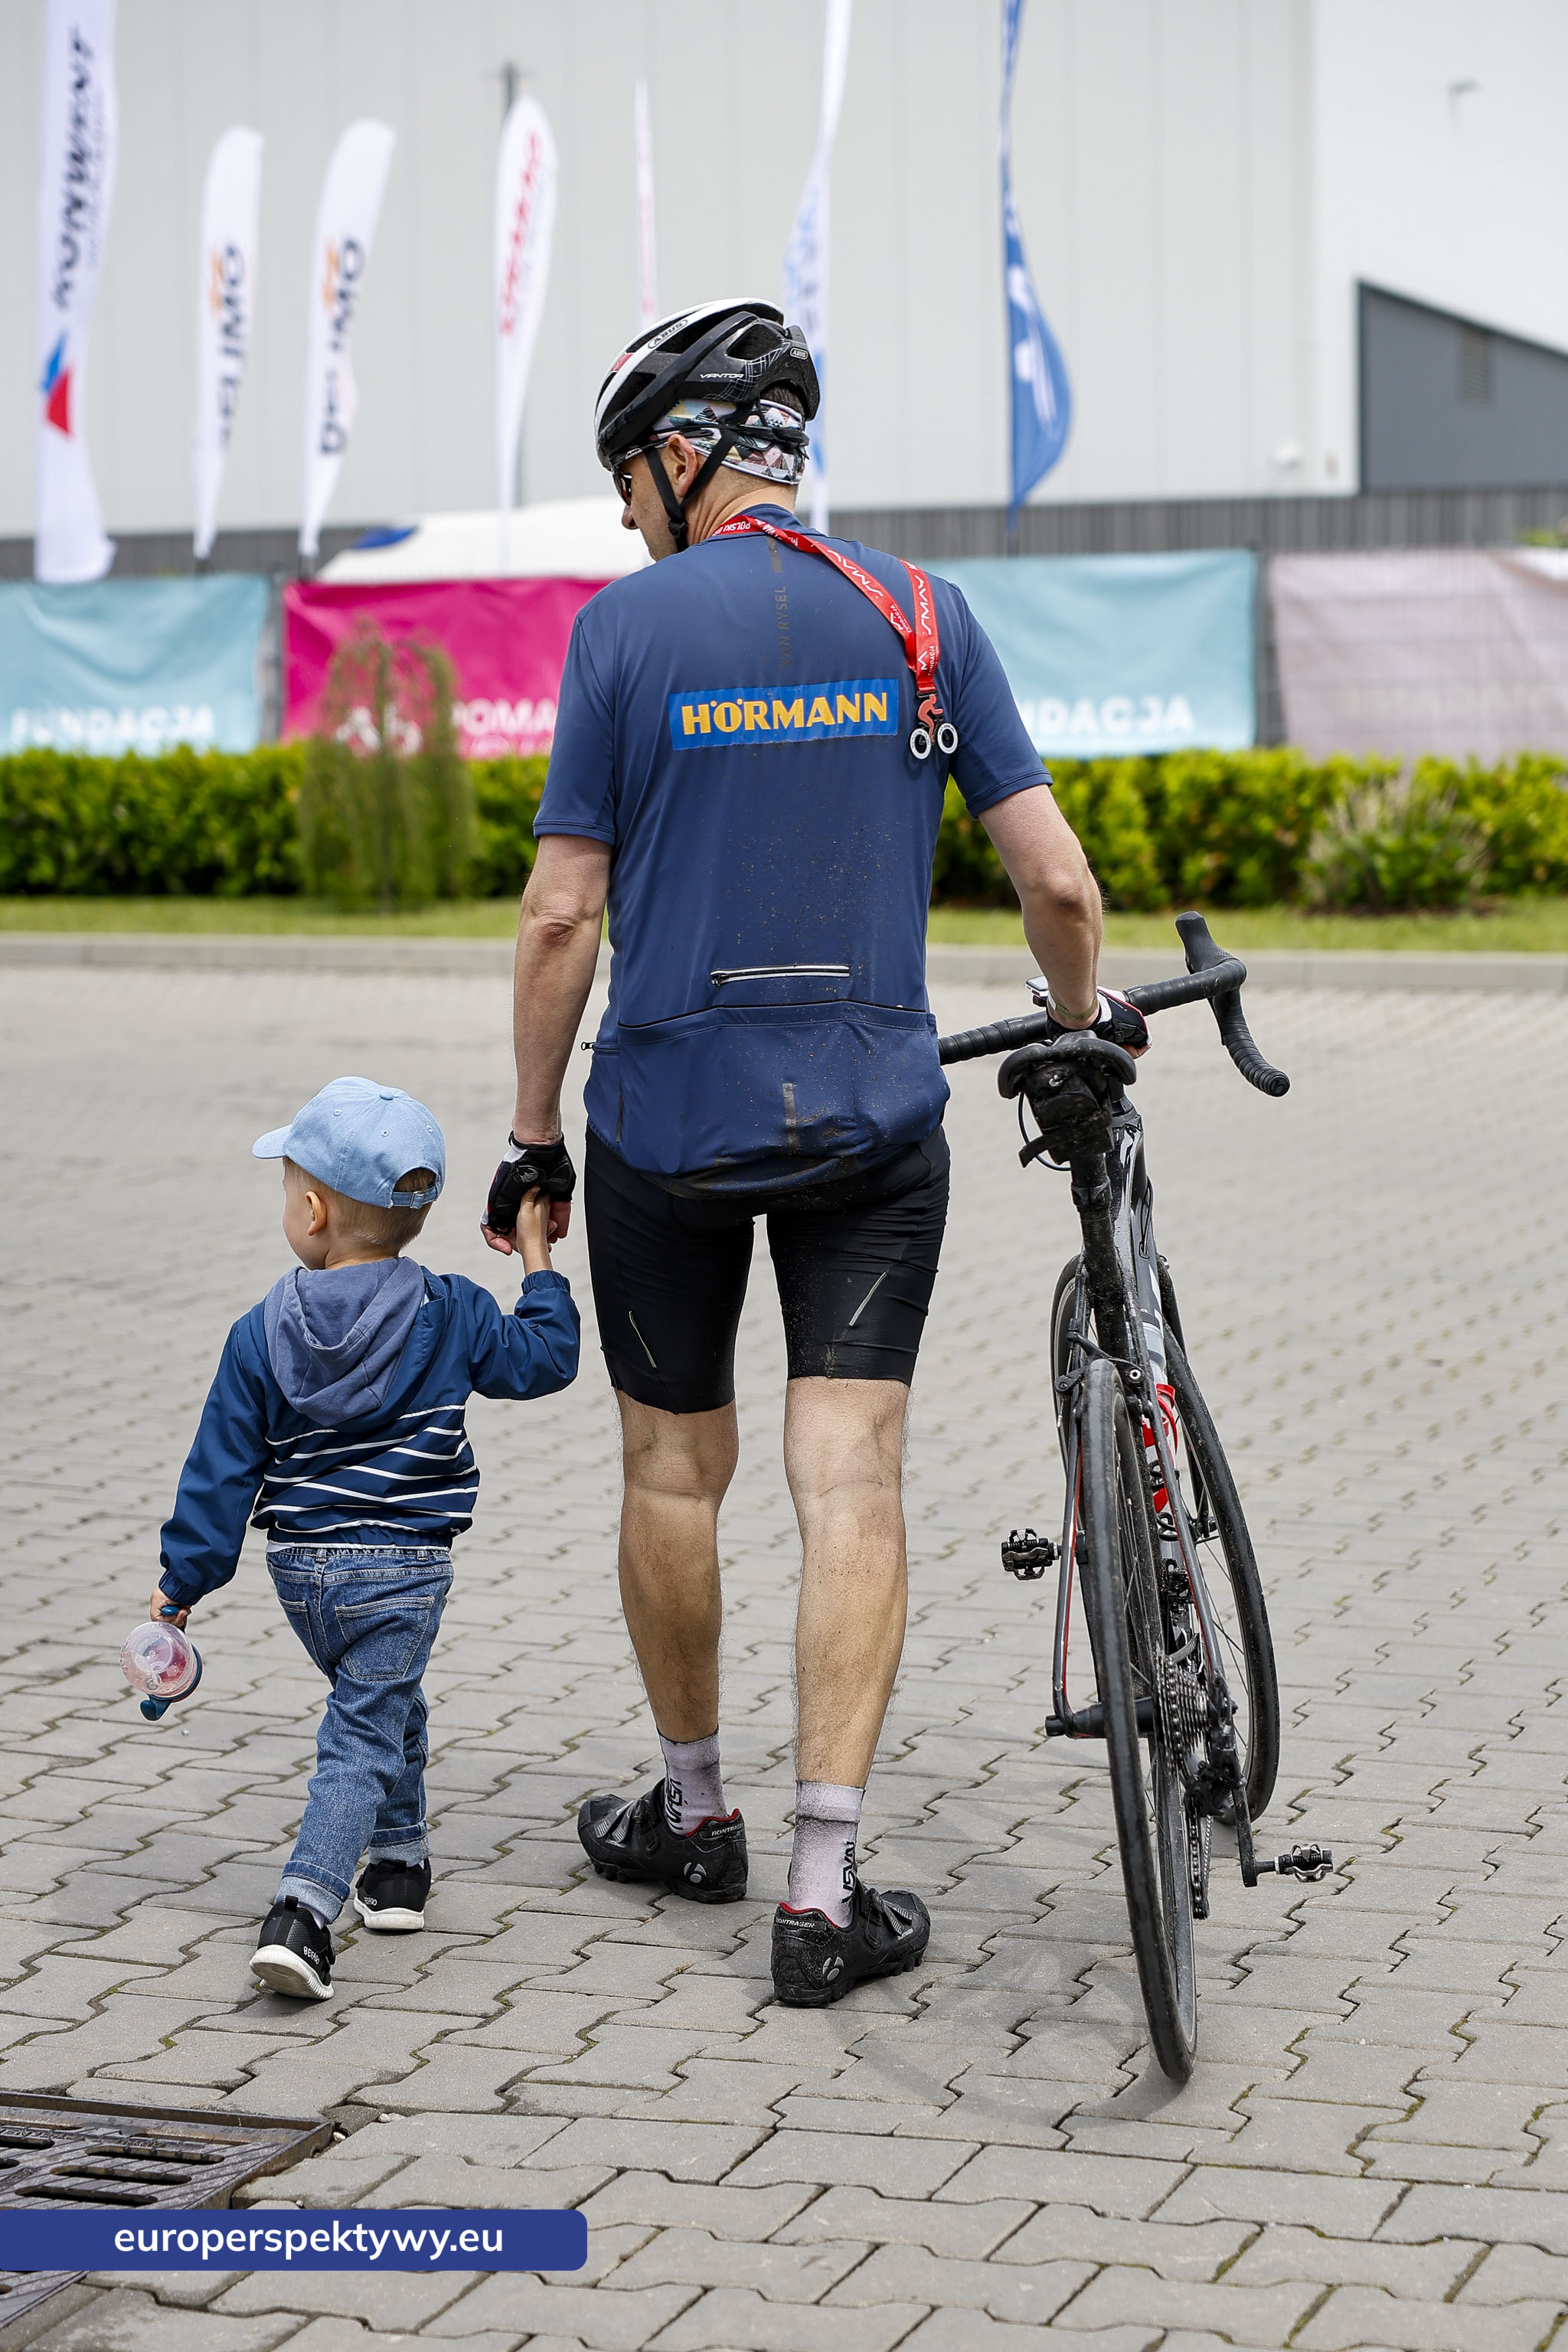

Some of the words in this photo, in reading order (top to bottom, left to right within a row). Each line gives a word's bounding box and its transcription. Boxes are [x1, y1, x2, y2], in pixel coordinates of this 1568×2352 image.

[653, 322, 683, 345] ABUS
[792, 349, 806, 358] ABUS
[723, 521, 750, 532] POLSKI
[775, 586, 790, 630] RYSEL
[779, 636, 791, 668] VAN
[681, 691, 887, 735] HÖRMANN
[665, 1777, 684, 1831] NASA
